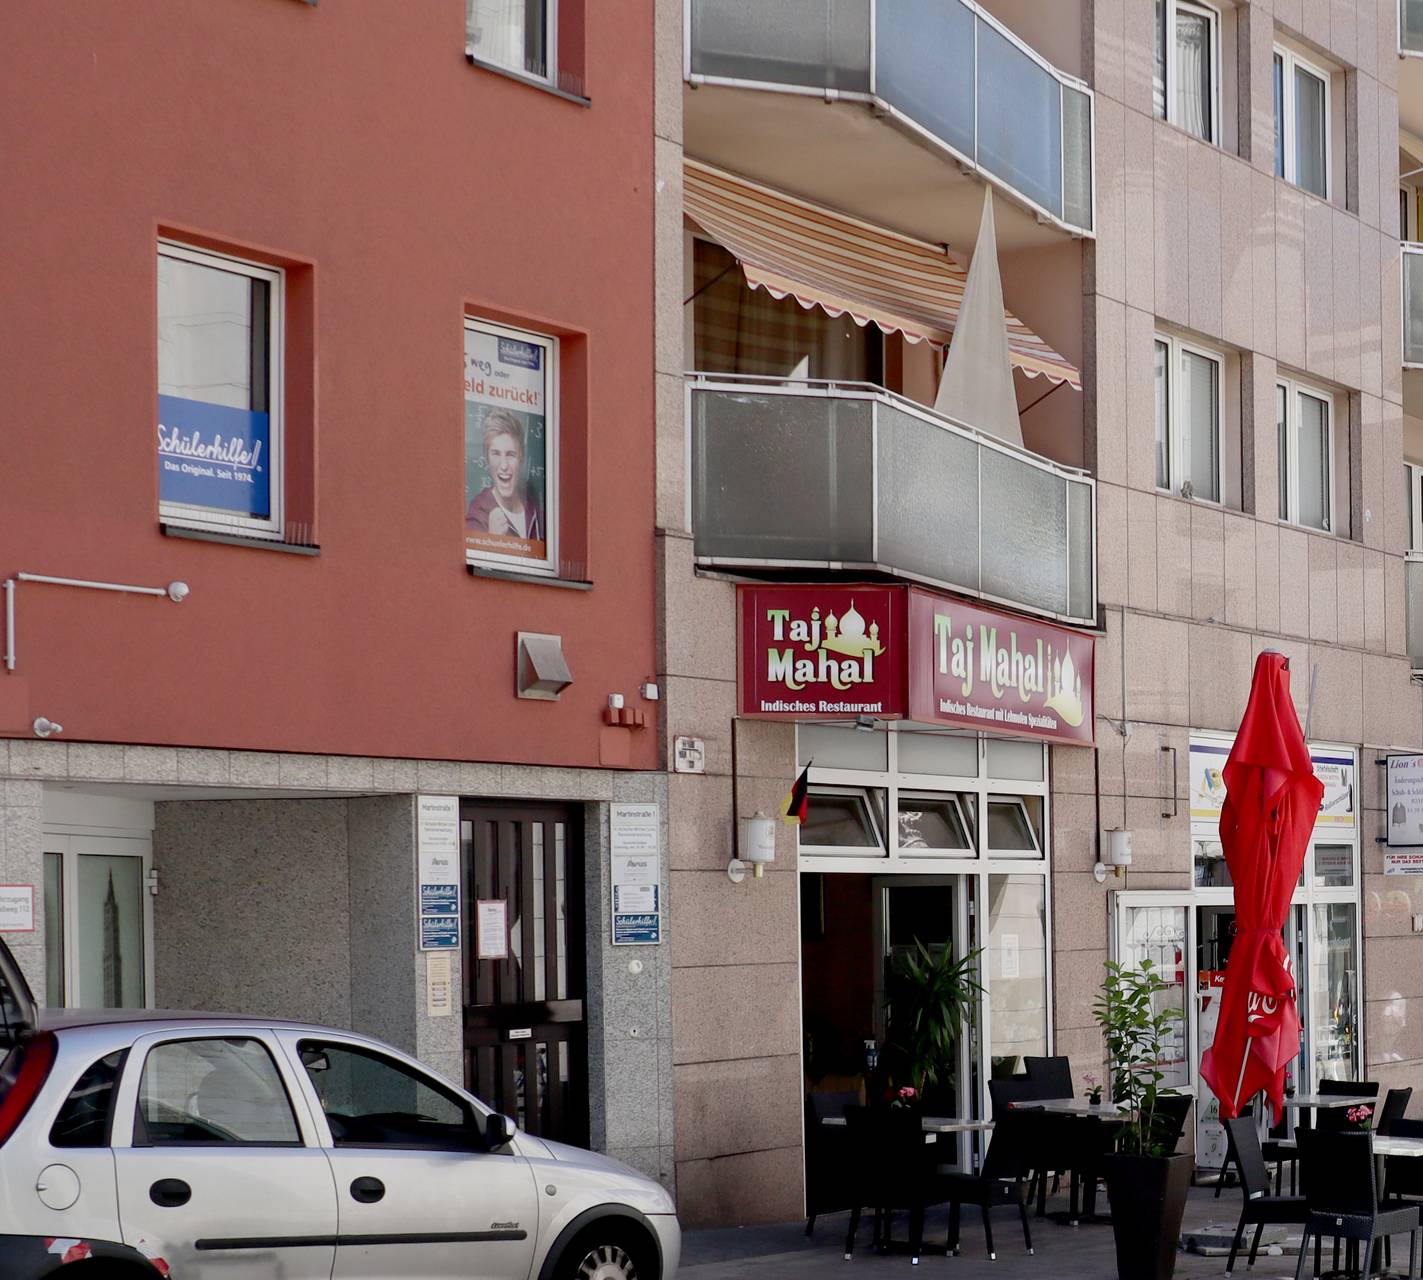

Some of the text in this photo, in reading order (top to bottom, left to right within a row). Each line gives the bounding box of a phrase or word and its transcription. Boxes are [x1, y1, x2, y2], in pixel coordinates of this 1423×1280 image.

[470, 358, 492, 376] weg
[489, 385, 538, 406] zurück!
[157, 423, 262, 470] Schülerhilfe!
[164, 460, 180, 472] Das
[181, 464, 215, 477] Original.
[217, 469, 232, 480] Seit
[767, 607, 822, 652] Taj
[767, 648, 875, 691] Mahal
[934, 614, 1044, 703] Taj Mahal
[761, 700, 883, 712] Indisches Restaurant
[940, 698, 1057, 729] Indisches Restaurant mit Lehmofen Spezialitäten
